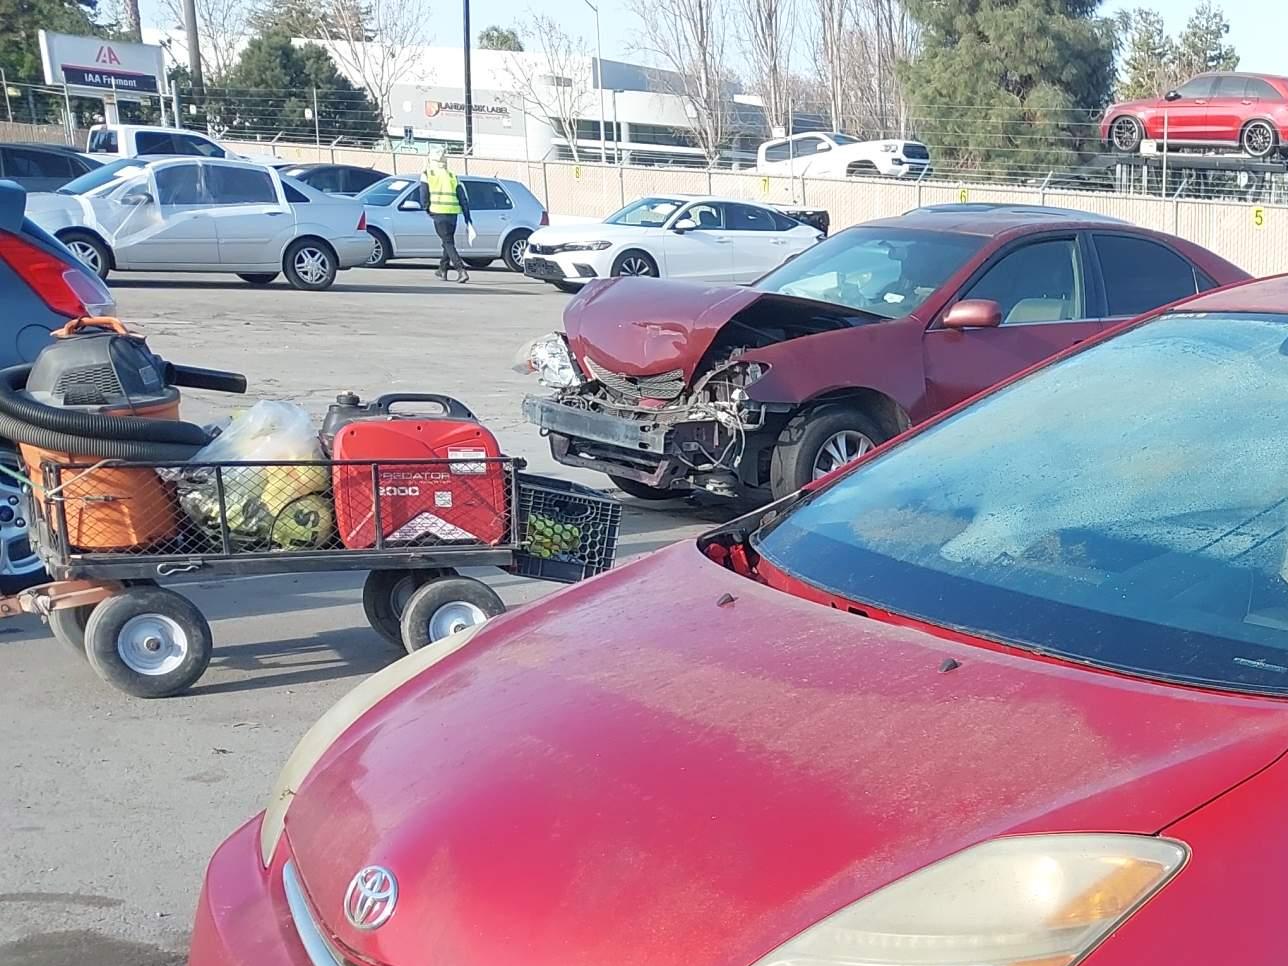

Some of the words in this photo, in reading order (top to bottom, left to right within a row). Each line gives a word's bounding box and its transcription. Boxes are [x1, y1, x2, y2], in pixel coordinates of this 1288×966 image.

[84, 73, 101, 83] IAA
[486, 105, 511, 114] LABEL
[761, 179, 767, 193] 7
[959, 189, 967, 203] 6
[1254, 211, 1264, 227] 5
[379, 471, 450, 480] REDATOR
